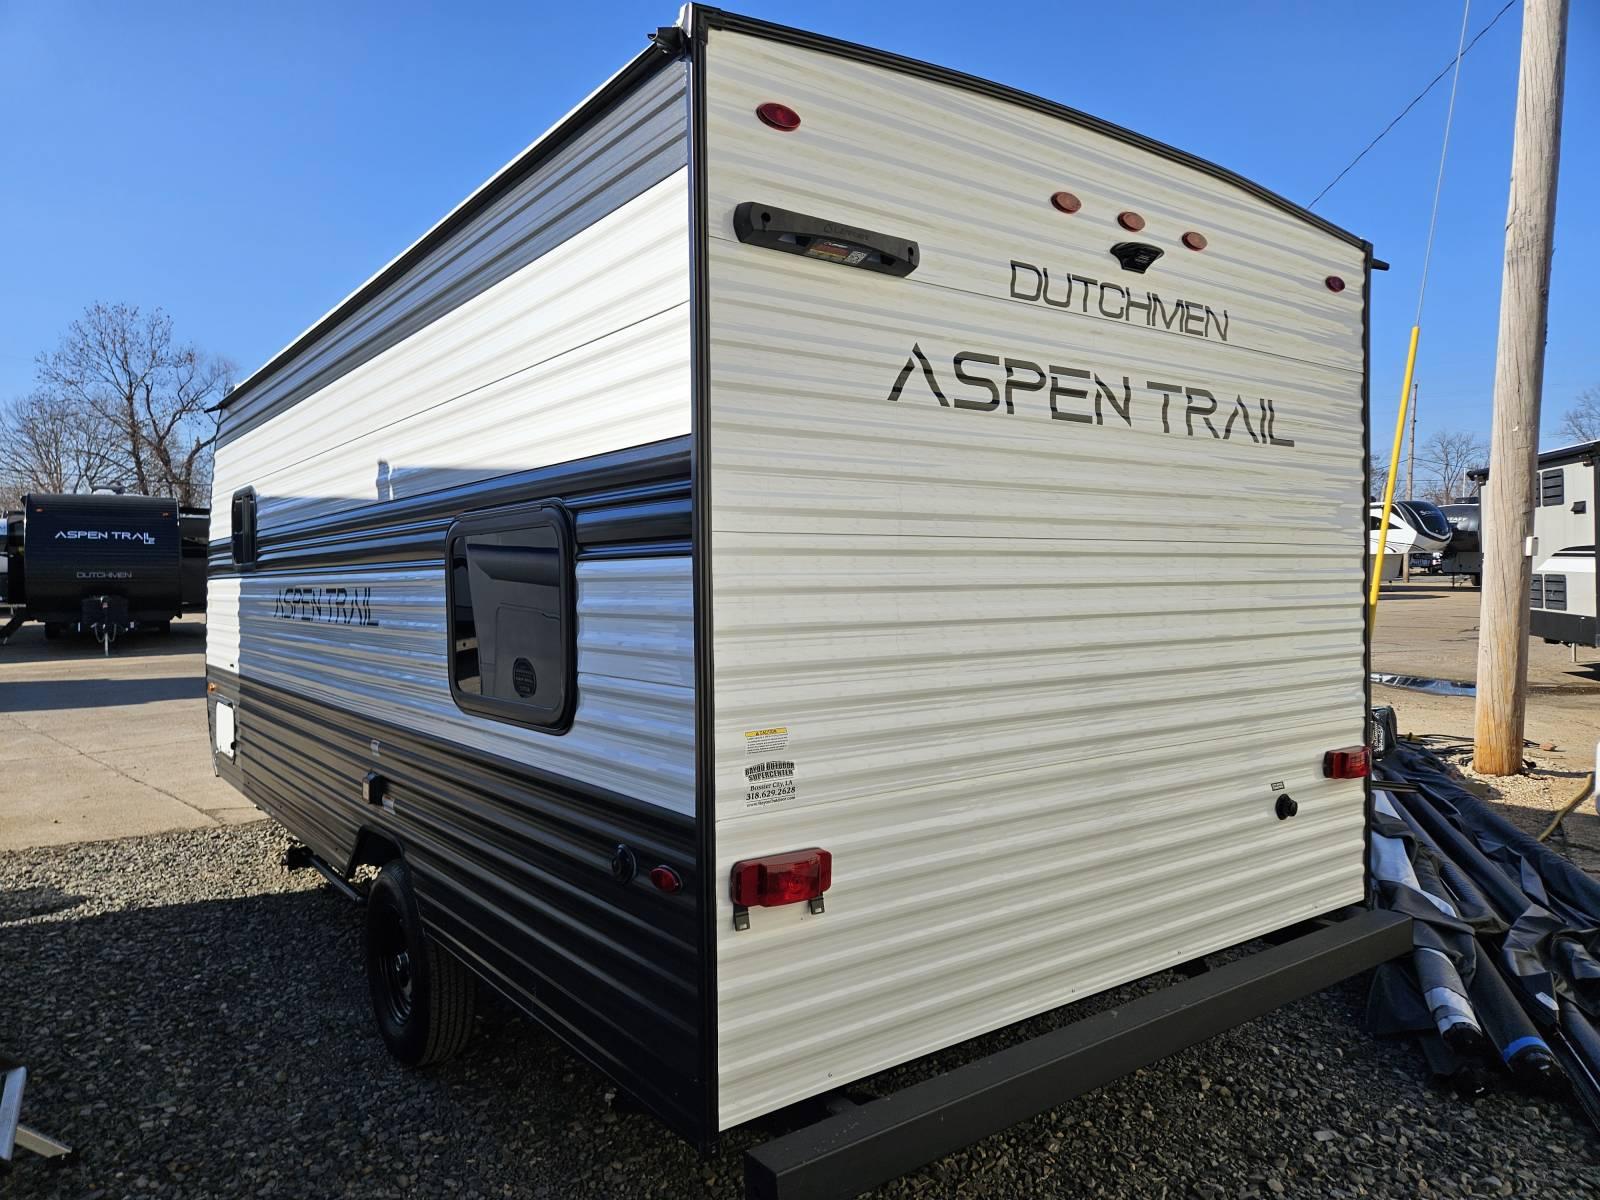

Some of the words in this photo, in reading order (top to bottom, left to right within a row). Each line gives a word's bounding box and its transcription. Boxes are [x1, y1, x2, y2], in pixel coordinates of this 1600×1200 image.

[1010, 259, 1229, 342] DUTCHMEN
[887, 341, 1132, 428] ASPEN
[1146, 380, 1296, 448] TRAIL
[55, 531, 108, 540] ASPEN
[274, 587, 322, 622] ASPEN
[326, 587, 379, 627] TRAIL
[745, 764, 765, 776] BAYOU
[766, 761, 794, 770] OUTDOOR
[748, 770, 793, 781] SUPERCENTER
[746, 787, 795, 800] 318.629.2628
